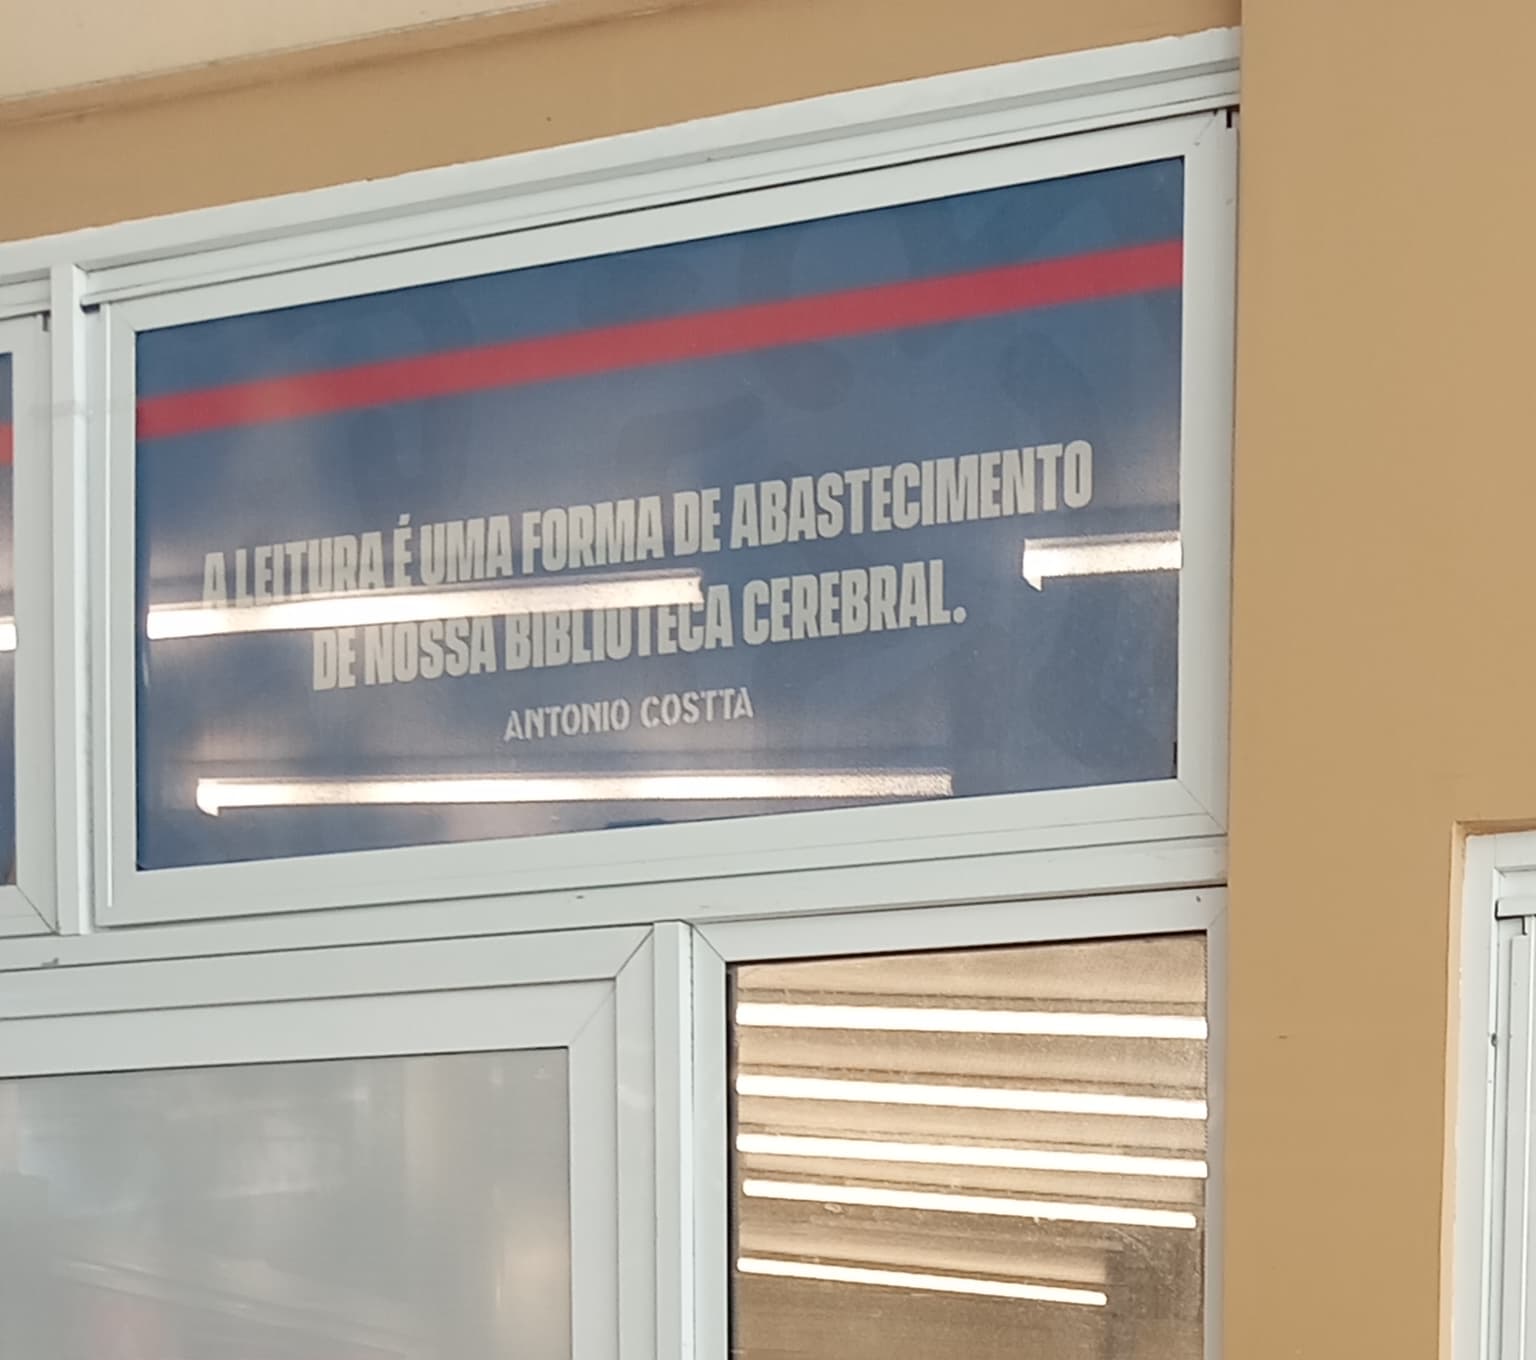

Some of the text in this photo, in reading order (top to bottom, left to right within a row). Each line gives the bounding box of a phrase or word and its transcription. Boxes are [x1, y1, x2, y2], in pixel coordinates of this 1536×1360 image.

[203, 439, 1093, 608] A LEITURA É UMA FORMA DE ABASTECIMENTO
[313, 559, 966, 691] DE NOSSA BIBLIOTECA CEREBRAL.
[503, 687, 754, 742] ANTONIO COSTTA
